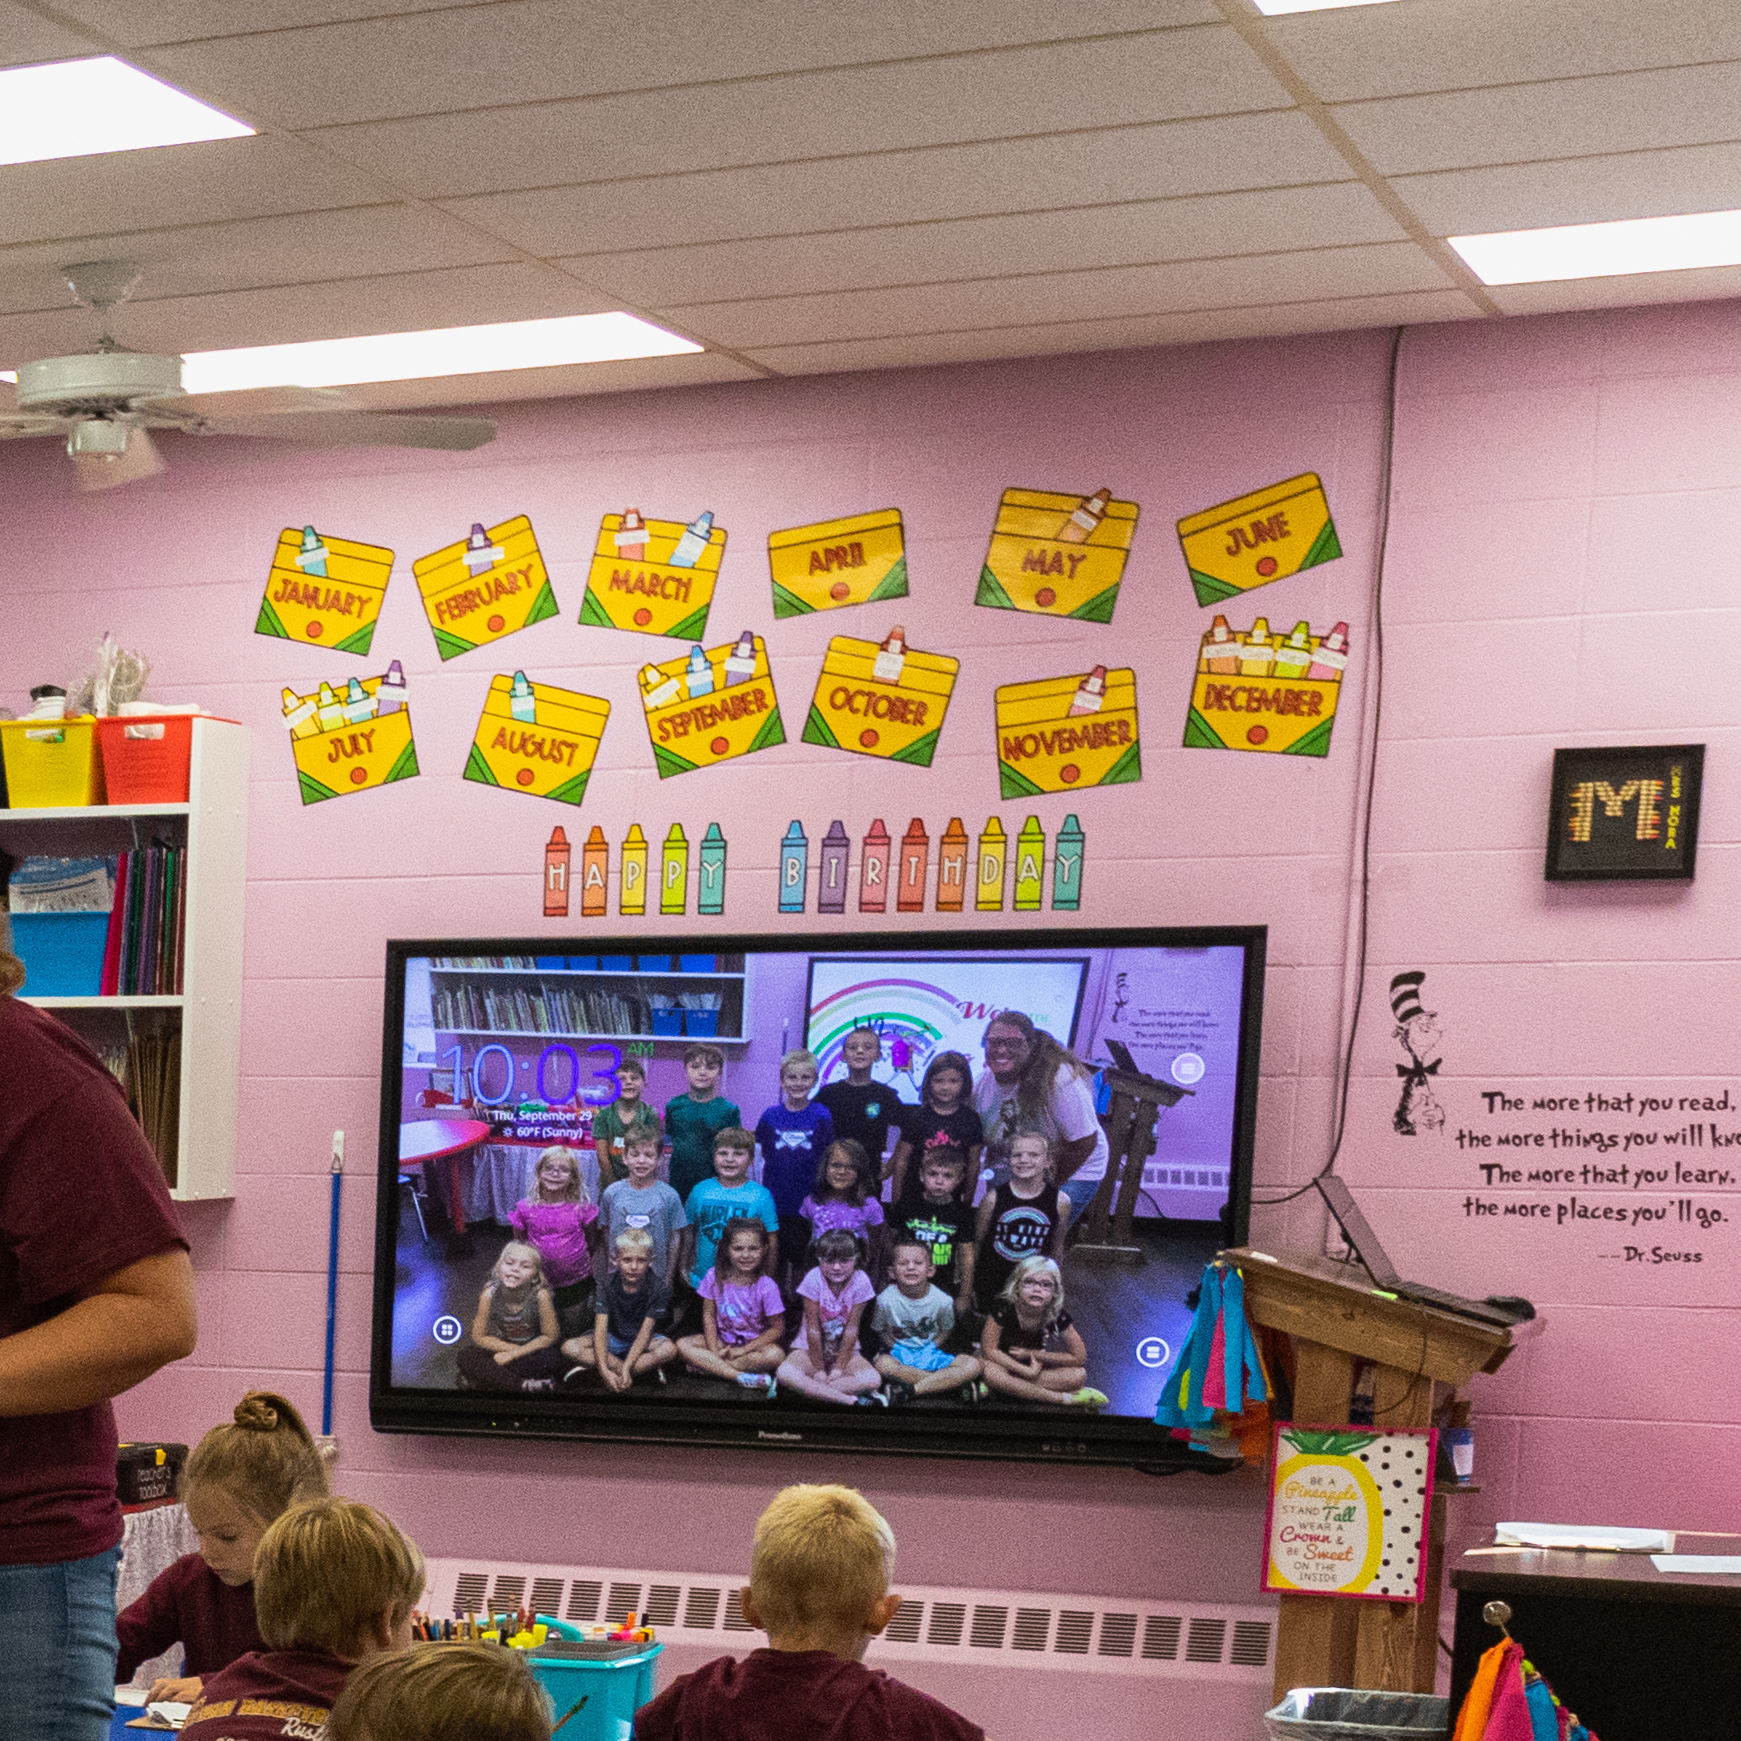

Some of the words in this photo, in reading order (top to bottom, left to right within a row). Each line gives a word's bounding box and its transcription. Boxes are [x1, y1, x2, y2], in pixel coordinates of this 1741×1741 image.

[1225, 511, 1292, 557] JUNE
[809, 542, 867, 575] APRIL
[1021, 549, 1087, 579] MAY
[274, 579, 373, 619] JANUARY
[435, 564, 534, 625] FEBRUARY
[610, 570, 692, 603] MARCH
[657, 688, 768, 742] SEPTEMBER
[829, 686, 929, 726] OCTOBER
[1203, 683, 1323, 717] DECEMBER
[328, 728, 376, 763] JULY
[491, 727, 579, 767] AUGUST
[1002, 719, 1132, 761] NOVEMBER
[547, 860, 722, 891] HAPPY
[785, 855, 1077, 888] BIRTHDAY
[442, 1043, 622, 1106] 10:03
[627, 1042, 654, 1056] AM
[494, 1111, 516, 1122] Thu,
[518, 1111, 575, 1125] September
[579, 1111, 593, 1122] 29
[1481, 1091, 1524, 1114] The
[1584, 1092, 1634, 1113] that
[1638, 1098, 1673, 1117] you
[517, 1127, 540, 1138] 60°F
[542, 1127, 584, 1139] (Sunny)
[1455, 1128, 1492, 1149] the
[1550, 1128, 1618, 1153] things
[1623, 1132, 1658, 1152] you
[1664, 1123, 1702, 1147] will
[1479, 1163, 1522, 1185] The
[1580, 1164, 1630, 1185] that
[1634, 1169, 1669, 1189] you
[1462, 1196, 1498, 1217] the
[1557, 1197, 1627, 1225] places
[1632, 1199, 1692, 1226] you'll
[1696, 1208, 1729, 1229] go.
[1651, 1246, 1703, 1264] Seuss
[1285, 1481, 1357, 1505] Pineapple
[1282, 1505, 1319, 1515] STAND
[1323, 1506, 1356, 1522] Tall
[1298, 1522, 1331, 1531] WEAR
[1280, 1526, 1331, 1543] Crown
[1286, 1547, 1298, 1556] BE
[1304, 1543, 1353, 1561] Sweet
[1293, 1561, 1309, 1570] ON
[1315, 1563, 1335, 1571] THE
[1300, 1573, 1337, 1583] INSIDE
